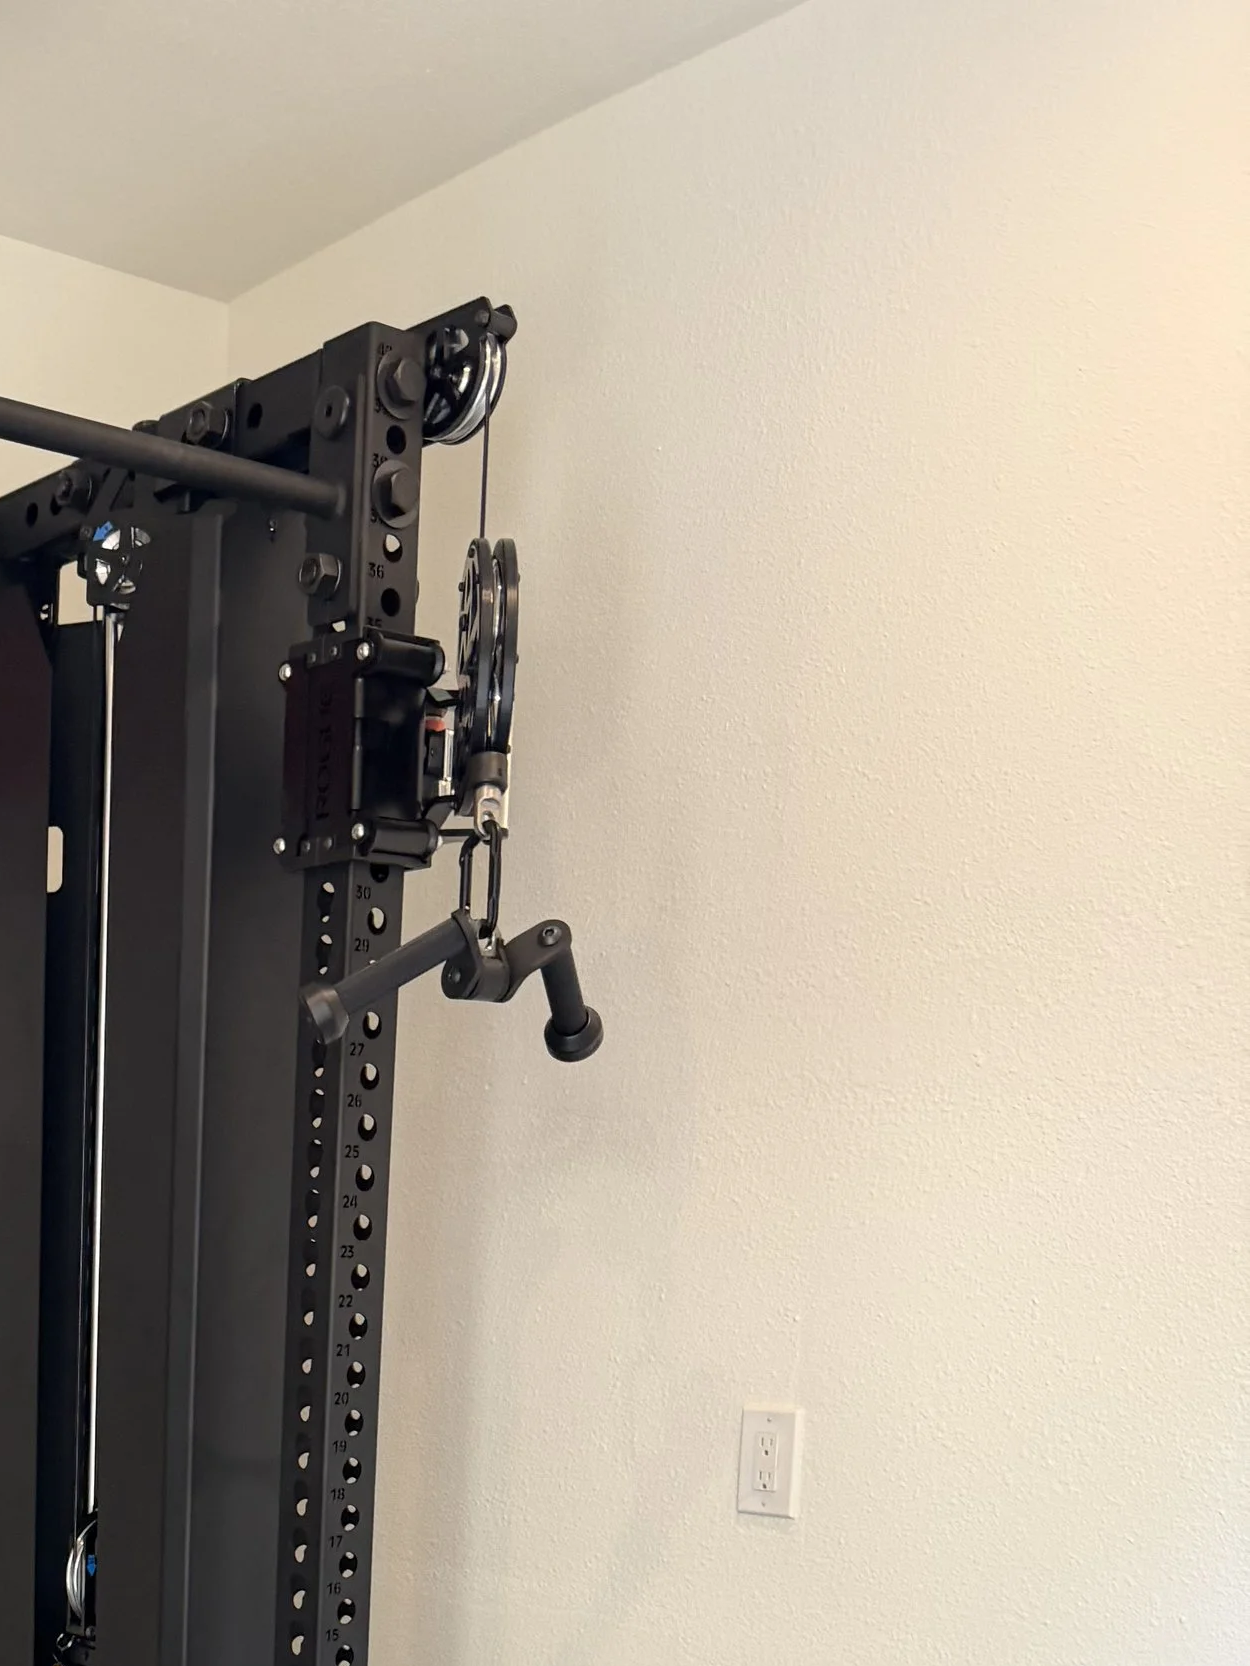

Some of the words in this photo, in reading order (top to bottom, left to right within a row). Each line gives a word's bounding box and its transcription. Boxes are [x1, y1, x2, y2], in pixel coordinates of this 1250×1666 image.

[369, 562, 385, 579] 36
[356, 885, 371, 899] 30
[354, 938, 369, 952] 29
[350, 1043, 364, 1056] 27
[347, 1094, 362, 1107] 26
[345, 1145, 359, 1158] 25
[343, 1195, 357, 1208] 24
[341, 1245, 354, 1258] 23
[338, 1295, 353, 1307] 22
[336, 1344, 350, 1357] 21
[334, 1392, 349, 1405] 20
[329, 1535, 342, 1548] 17
[327, 1582, 341, 1595] 16
[326, 1629, 339, 1641] 15
